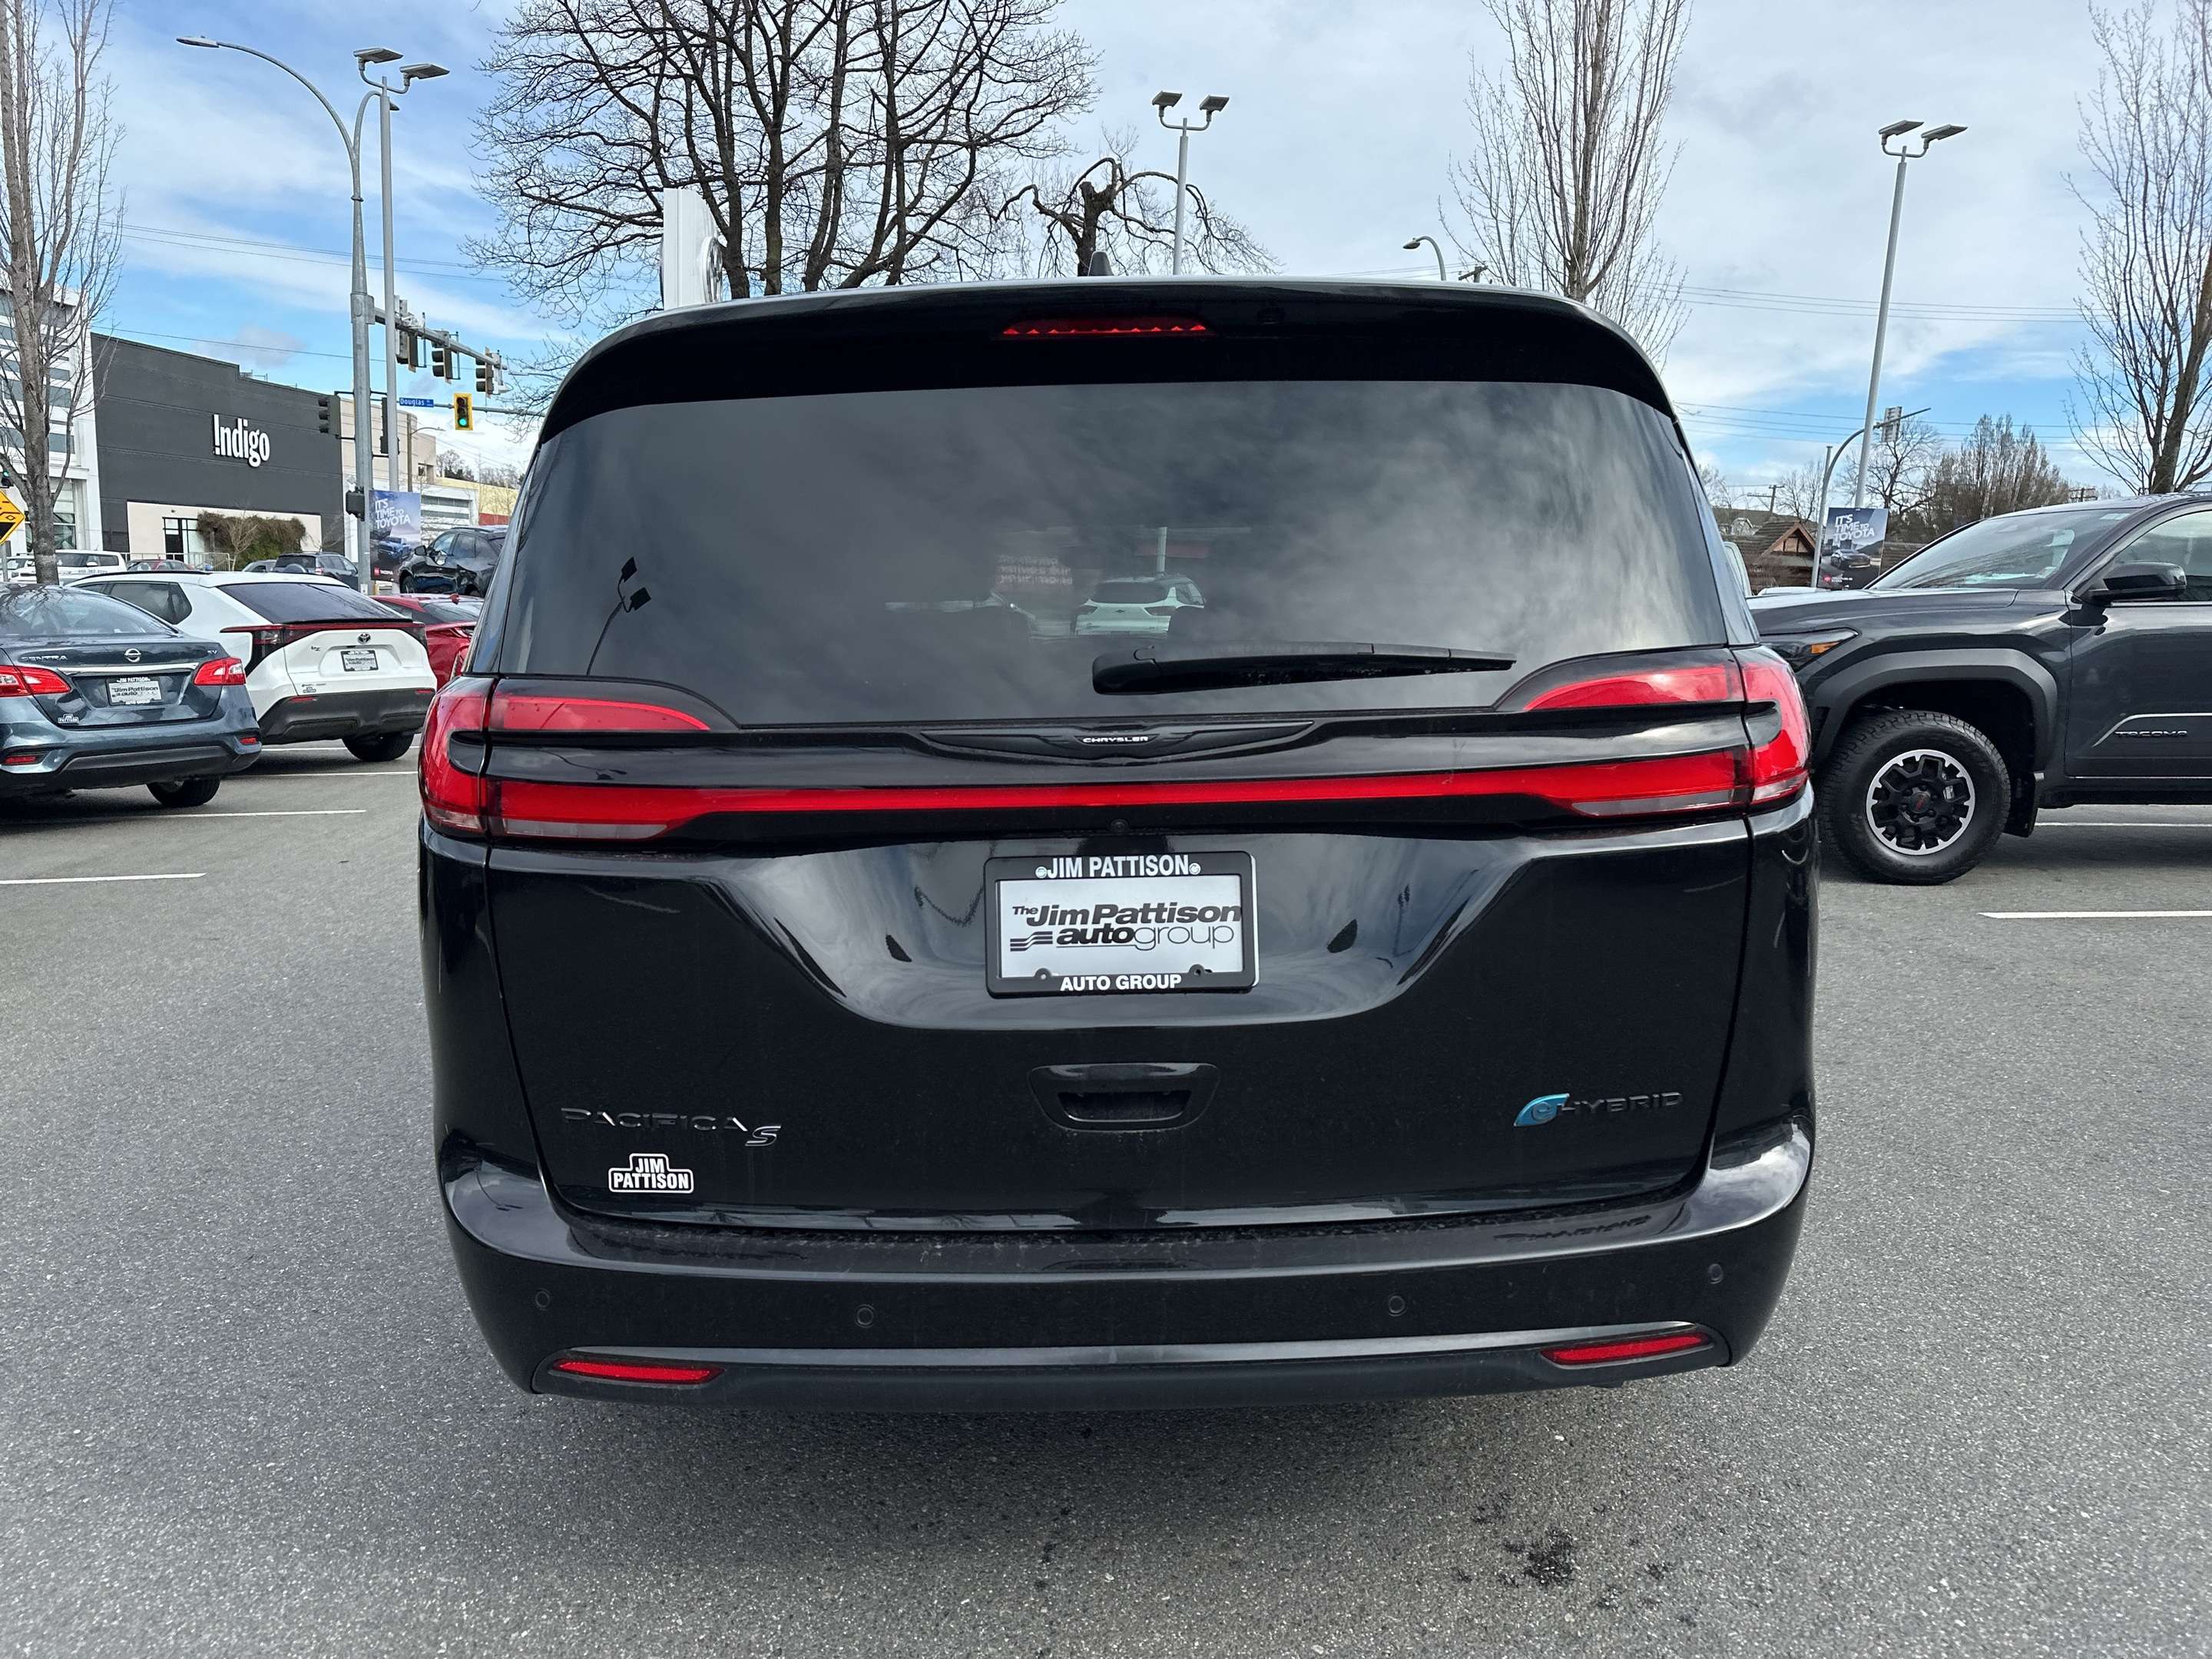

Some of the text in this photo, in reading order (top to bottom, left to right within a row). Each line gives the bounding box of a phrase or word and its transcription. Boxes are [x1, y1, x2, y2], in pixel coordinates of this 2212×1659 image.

[400, 398, 425, 407] Douglas
[214, 414, 270, 468] Indigo
[375, 498, 389, 510] IT'S
[376, 507, 395, 519] TIME
[1835, 514, 1853, 525] IT'S
[375, 515, 411, 529] TOYOTA
[1835, 522, 1859, 533] TIME
[1834, 528, 1875, 542] TOYOTA
[1048, 854, 1189, 879] JIM PATTISON
[1012, 902, 1242, 926] The Jim Pattison
[1060, 974, 1182, 992] AUTO GROUP
[1557, 1091, 1684, 1114] HYBRID
[561, 1108, 782, 1147] PACIFICA S
[635, 1158, 665, 1173] JIM
[614, 1172, 689, 1189] PATTISON
